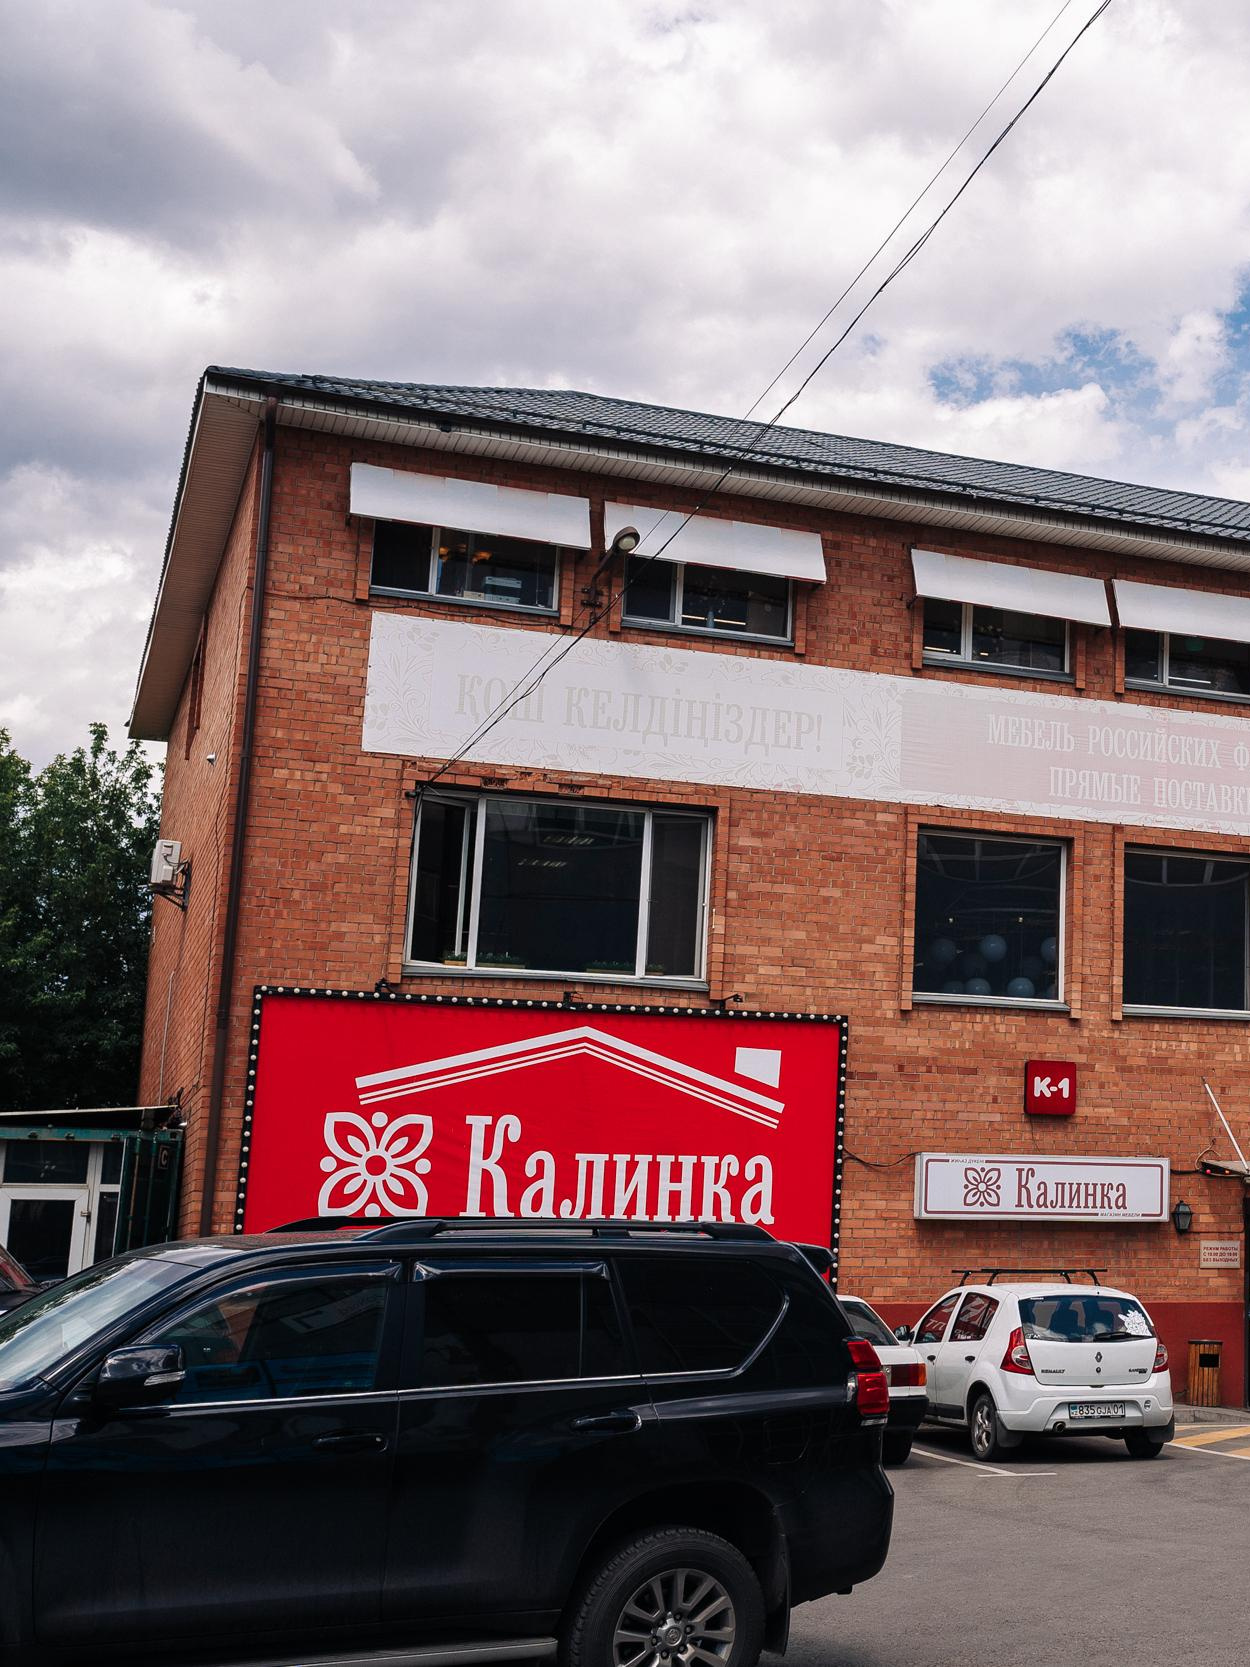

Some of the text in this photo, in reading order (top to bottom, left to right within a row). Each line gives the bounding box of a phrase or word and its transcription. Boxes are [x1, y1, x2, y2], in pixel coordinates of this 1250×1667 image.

[986, 713, 1076, 752] МЕБЕЛЬ
[1087, 724, 1222, 769] РОССИЙСКИХ
[1048, 766, 1142, 805] ПРЯМЫЕ
[460, 1114, 775, 1225] Калинка
[1015, 1167, 1128, 1210] Калинка
[1078, 1405, 1095, 1415] 835
[1114, 1404, 1124, 1414] 01
